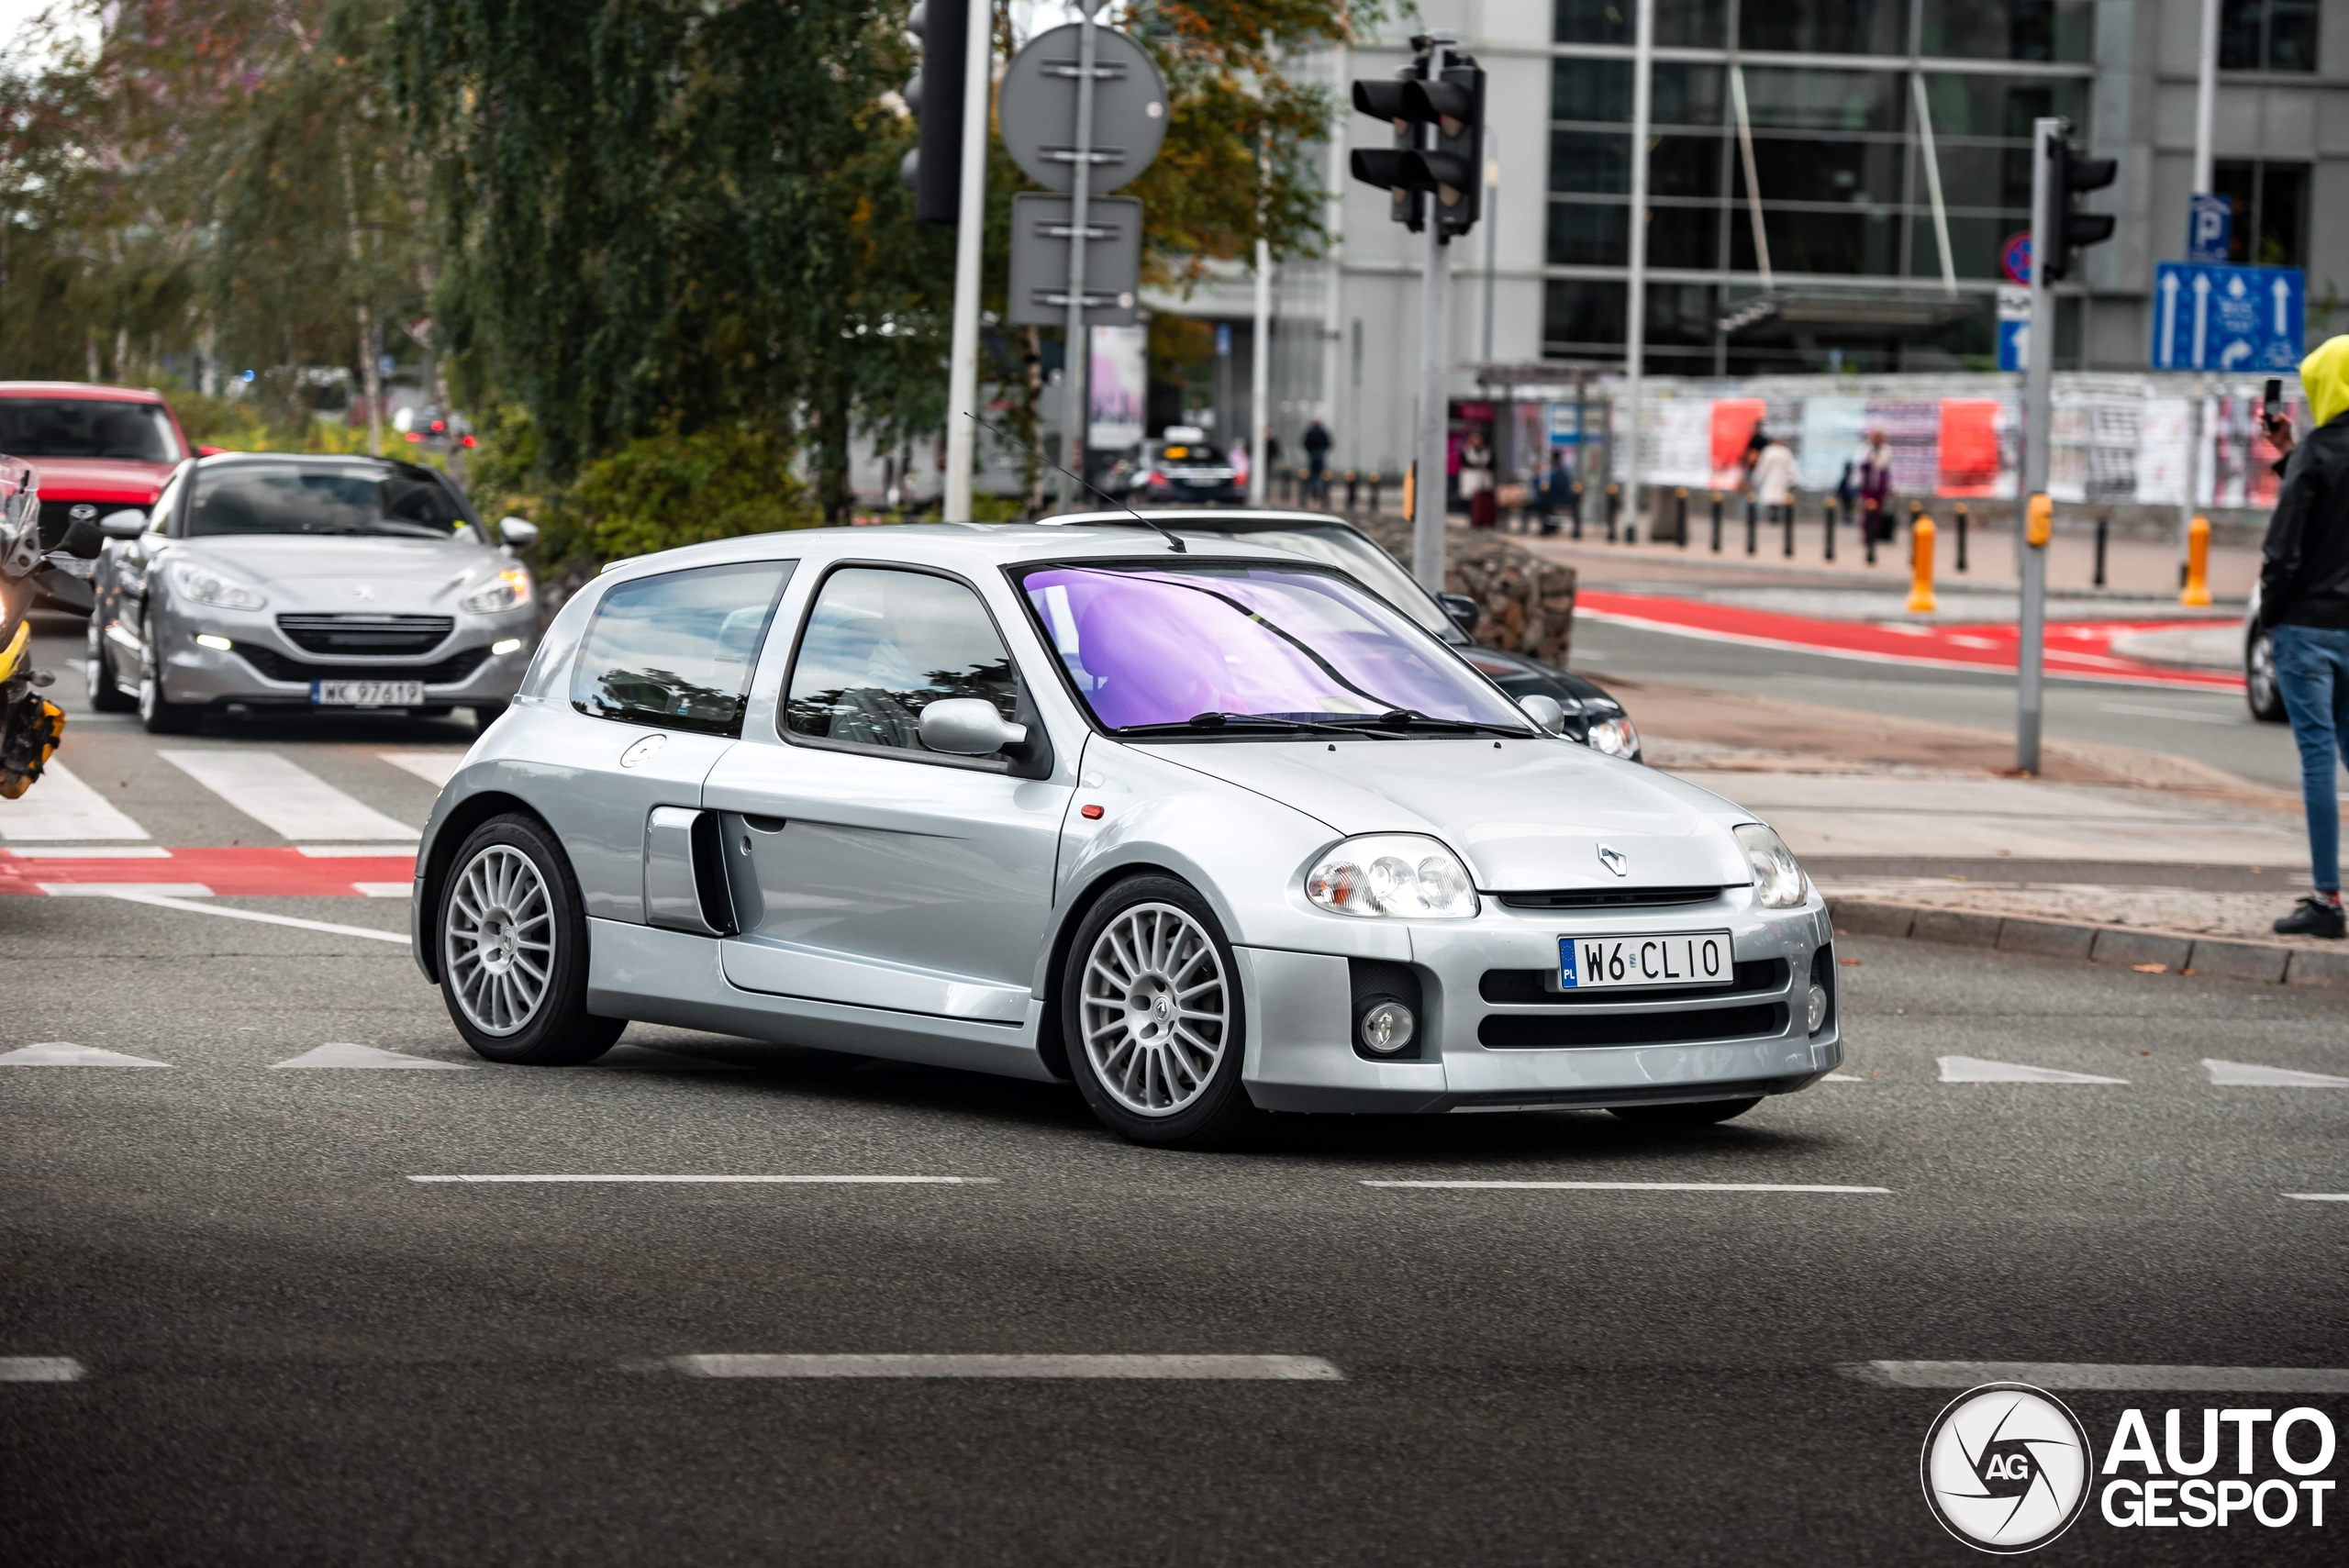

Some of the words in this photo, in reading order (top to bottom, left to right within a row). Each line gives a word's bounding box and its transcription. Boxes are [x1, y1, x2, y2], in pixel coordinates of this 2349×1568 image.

[2196, 211, 2221, 250] P
[1564, 969, 1575, 980] PL
[1585, 942, 1625, 982] W6
[1641, 939, 1720, 979] CLIO
